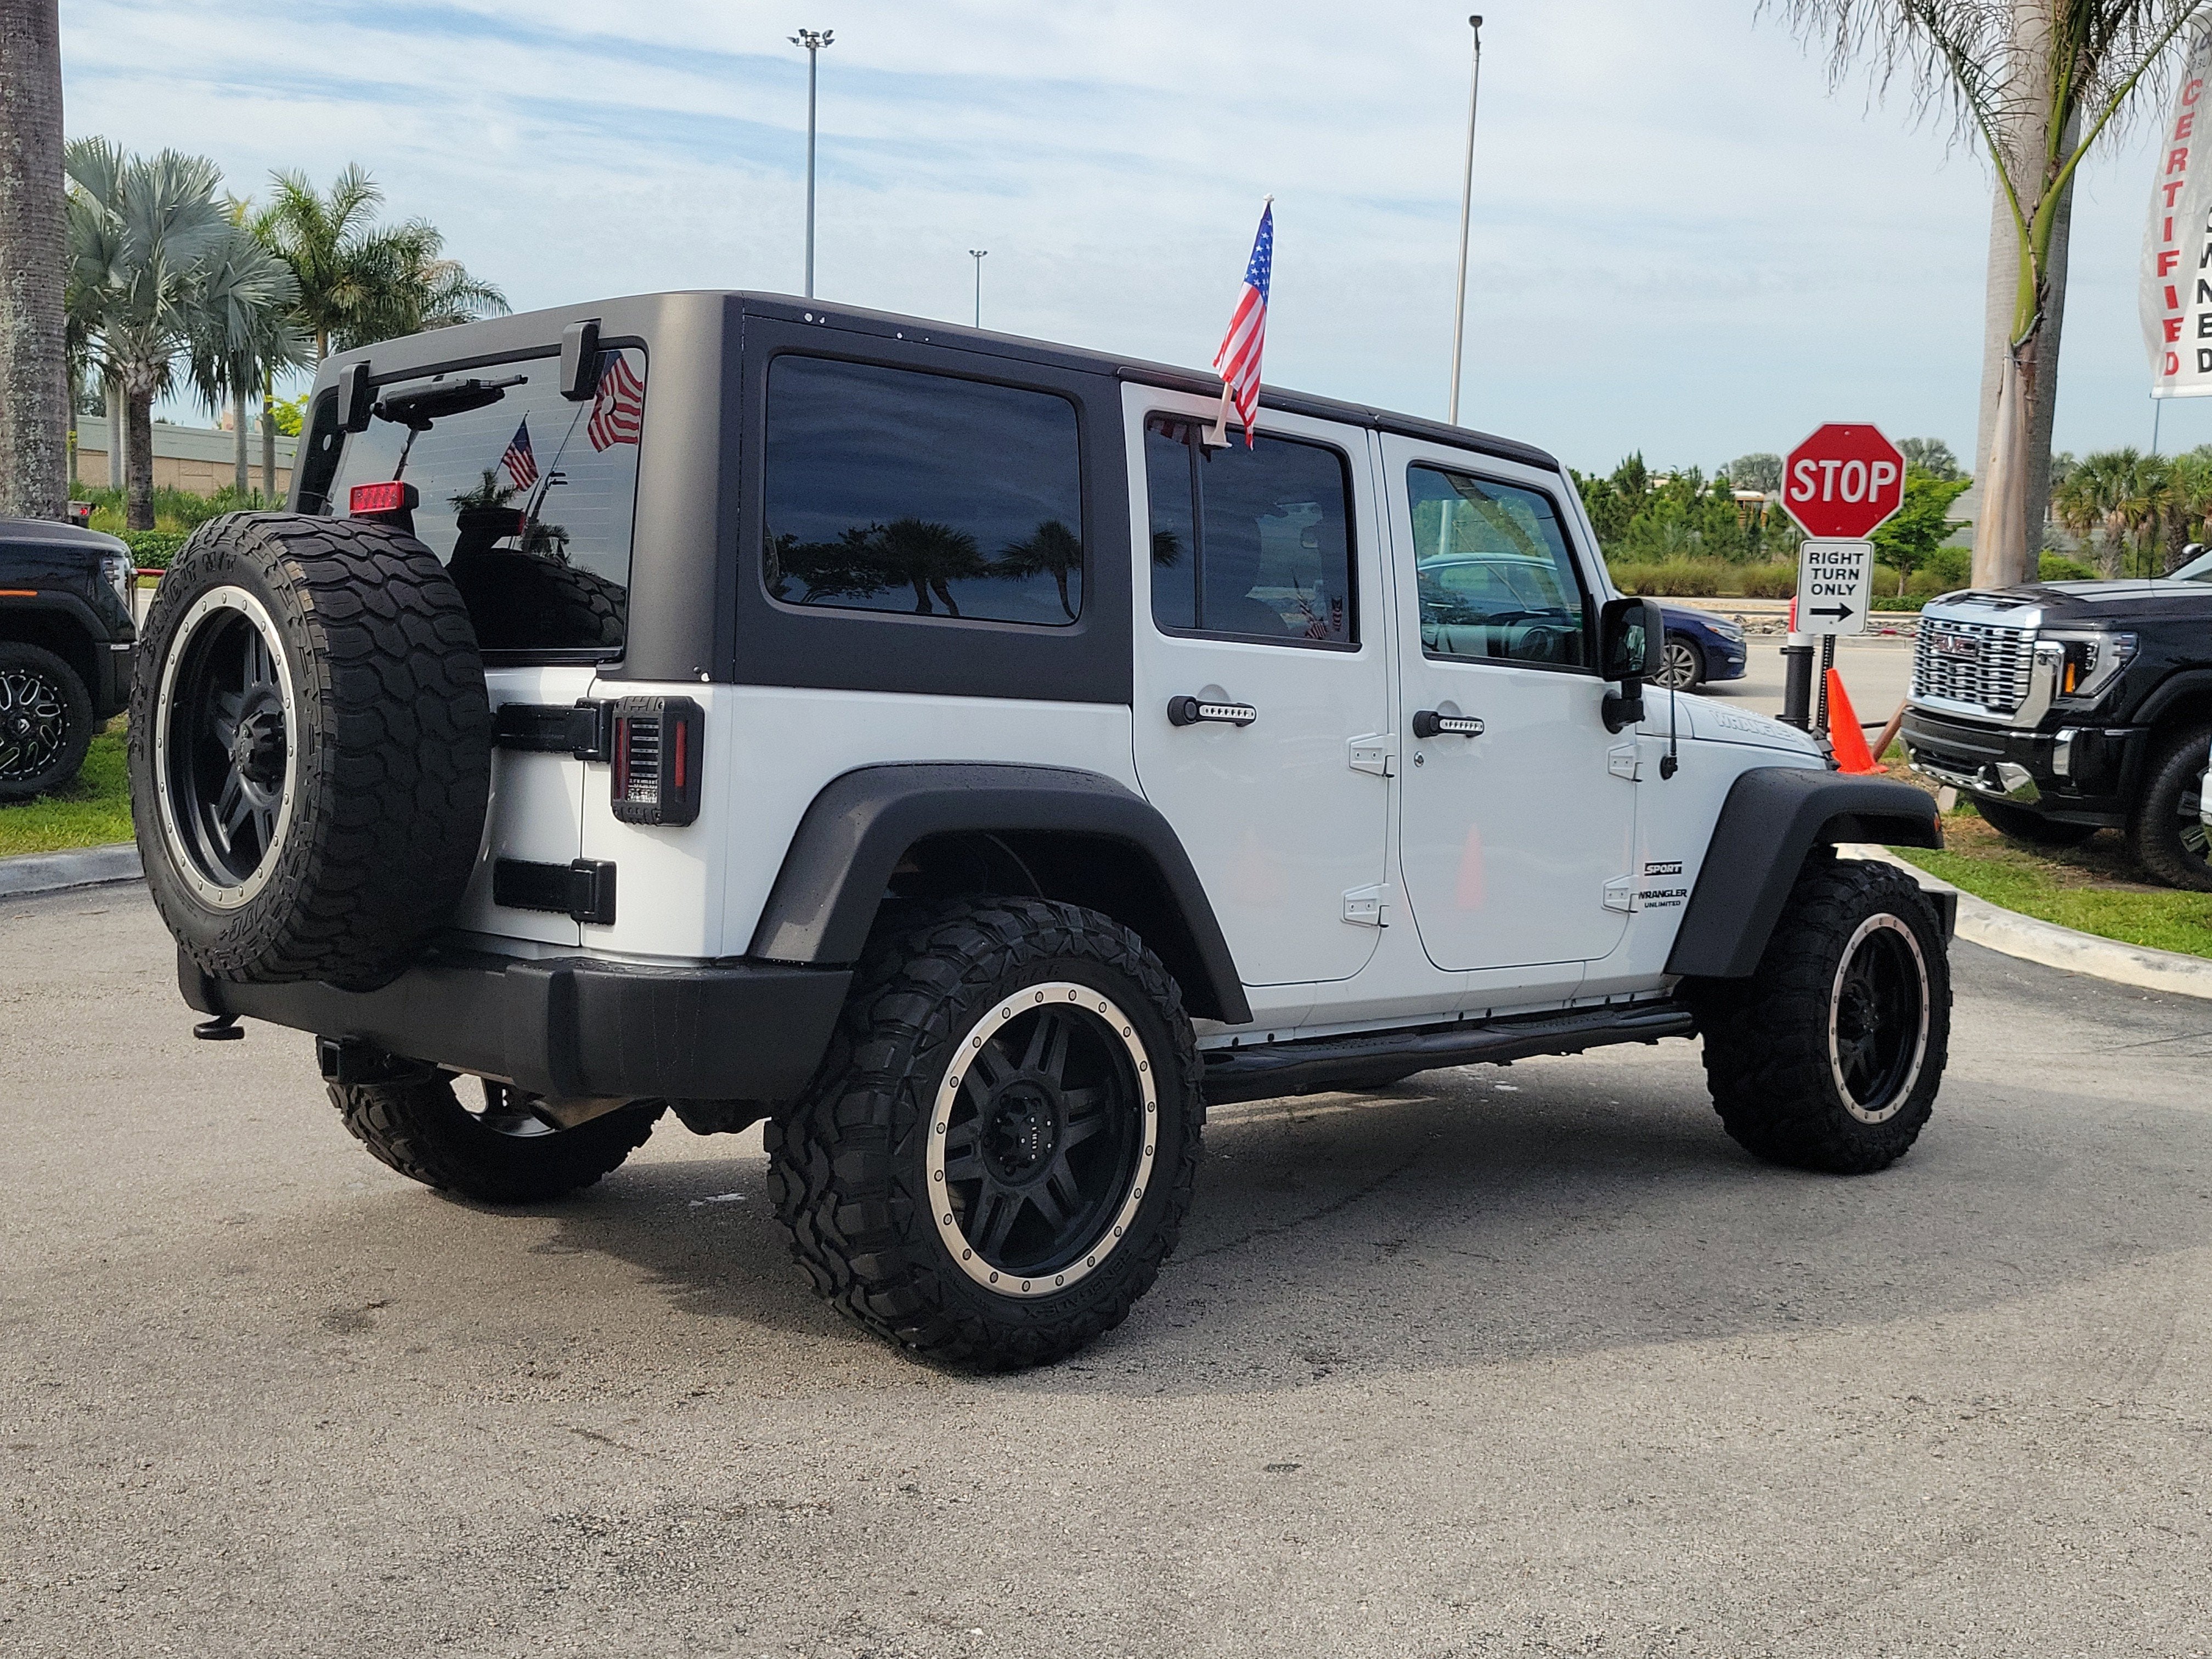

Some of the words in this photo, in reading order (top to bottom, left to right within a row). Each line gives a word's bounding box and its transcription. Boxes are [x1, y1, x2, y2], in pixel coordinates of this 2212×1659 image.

[2157, 78, 2203, 376] CERTIFIED
[1790, 459, 1897, 503] STOP
[1809, 552, 1864, 565] RIGHT
[1812, 568, 1859, 580] TURN
[1811, 584, 1857, 596] ONLY
[1645, 863, 1682, 874] SPORT
[1638, 889, 1688, 900] WRANGLER
